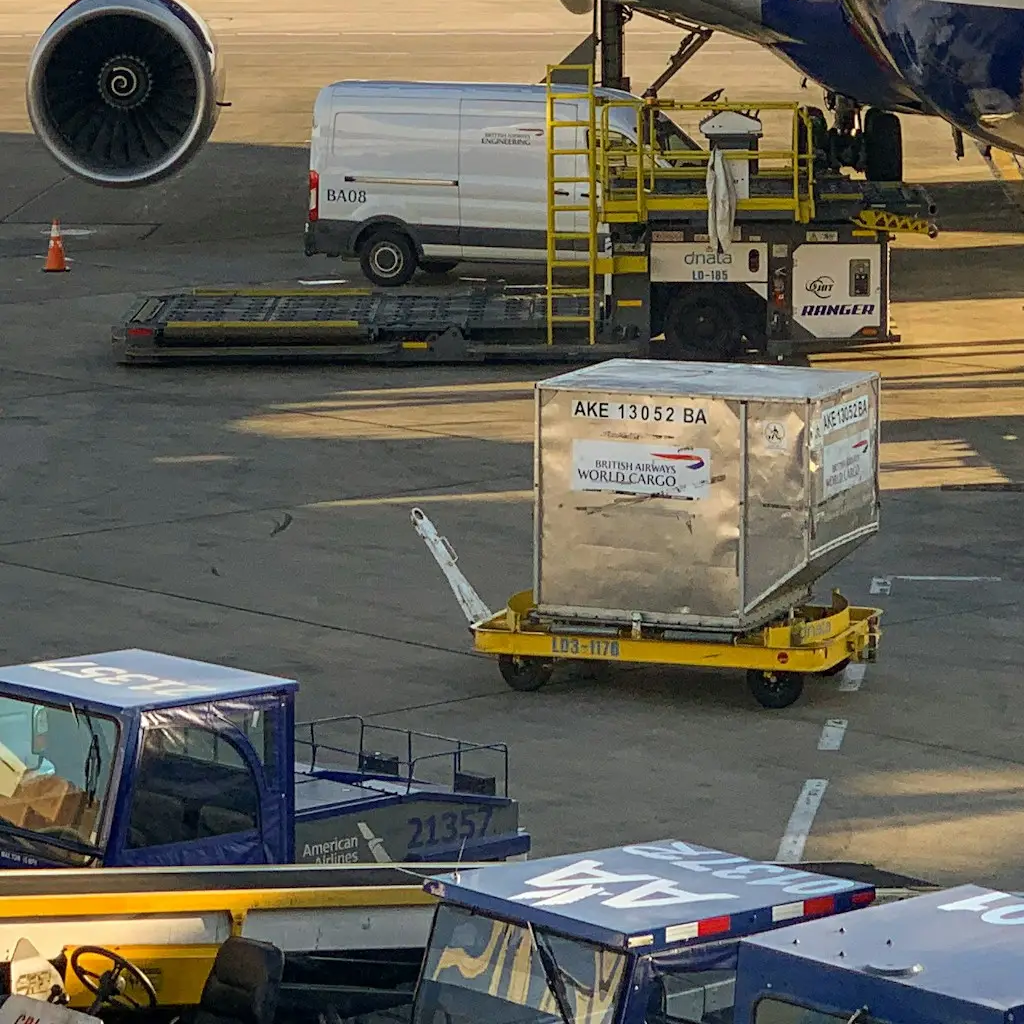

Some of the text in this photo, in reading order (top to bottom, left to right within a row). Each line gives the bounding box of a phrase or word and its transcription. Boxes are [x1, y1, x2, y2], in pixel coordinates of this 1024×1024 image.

[481, 138, 531, 146] ENGINEERING
[327, 189, 367, 204] BA08
[684, 251, 732, 265] dnata
[801, 304, 875, 316] RANGER
[574, 401, 707, 424] AKE 13052 BA
[823, 410, 837, 430] AKE
[858, 399, 868, 417] BA
[595, 459, 677, 474] BRITISH AIRWAYS
[577, 468, 677, 488] WORLD CARGO
[28, 661, 217, 697] 21357
[407, 805, 494, 850] 21357
[302, 836, 359, 858] American
[314, 850, 359, 865] Airlines
[524, 859, 740, 909] AA
